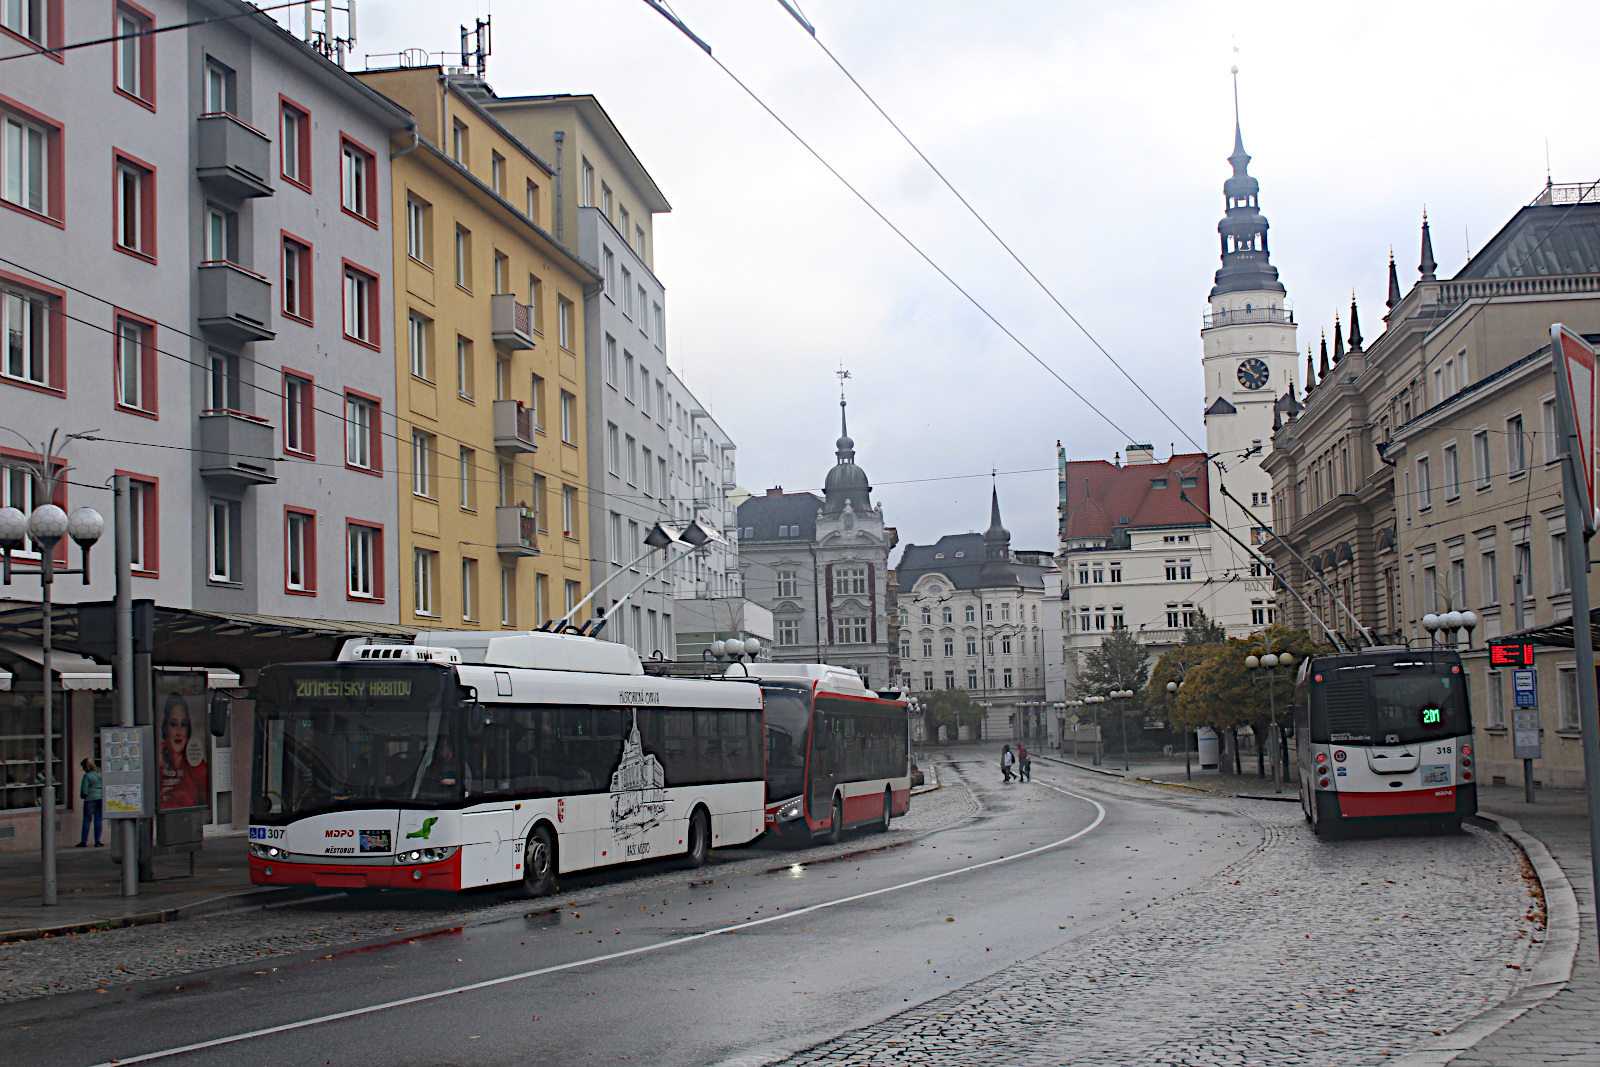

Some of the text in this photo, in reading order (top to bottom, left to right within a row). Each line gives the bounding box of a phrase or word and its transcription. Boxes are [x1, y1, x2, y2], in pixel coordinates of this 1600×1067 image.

[1422, 708, 1440, 723] 201
[1436, 746, 1452, 755] 318
[267, 828, 285, 840] 307
[324, 829, 355, 838] MDPO
